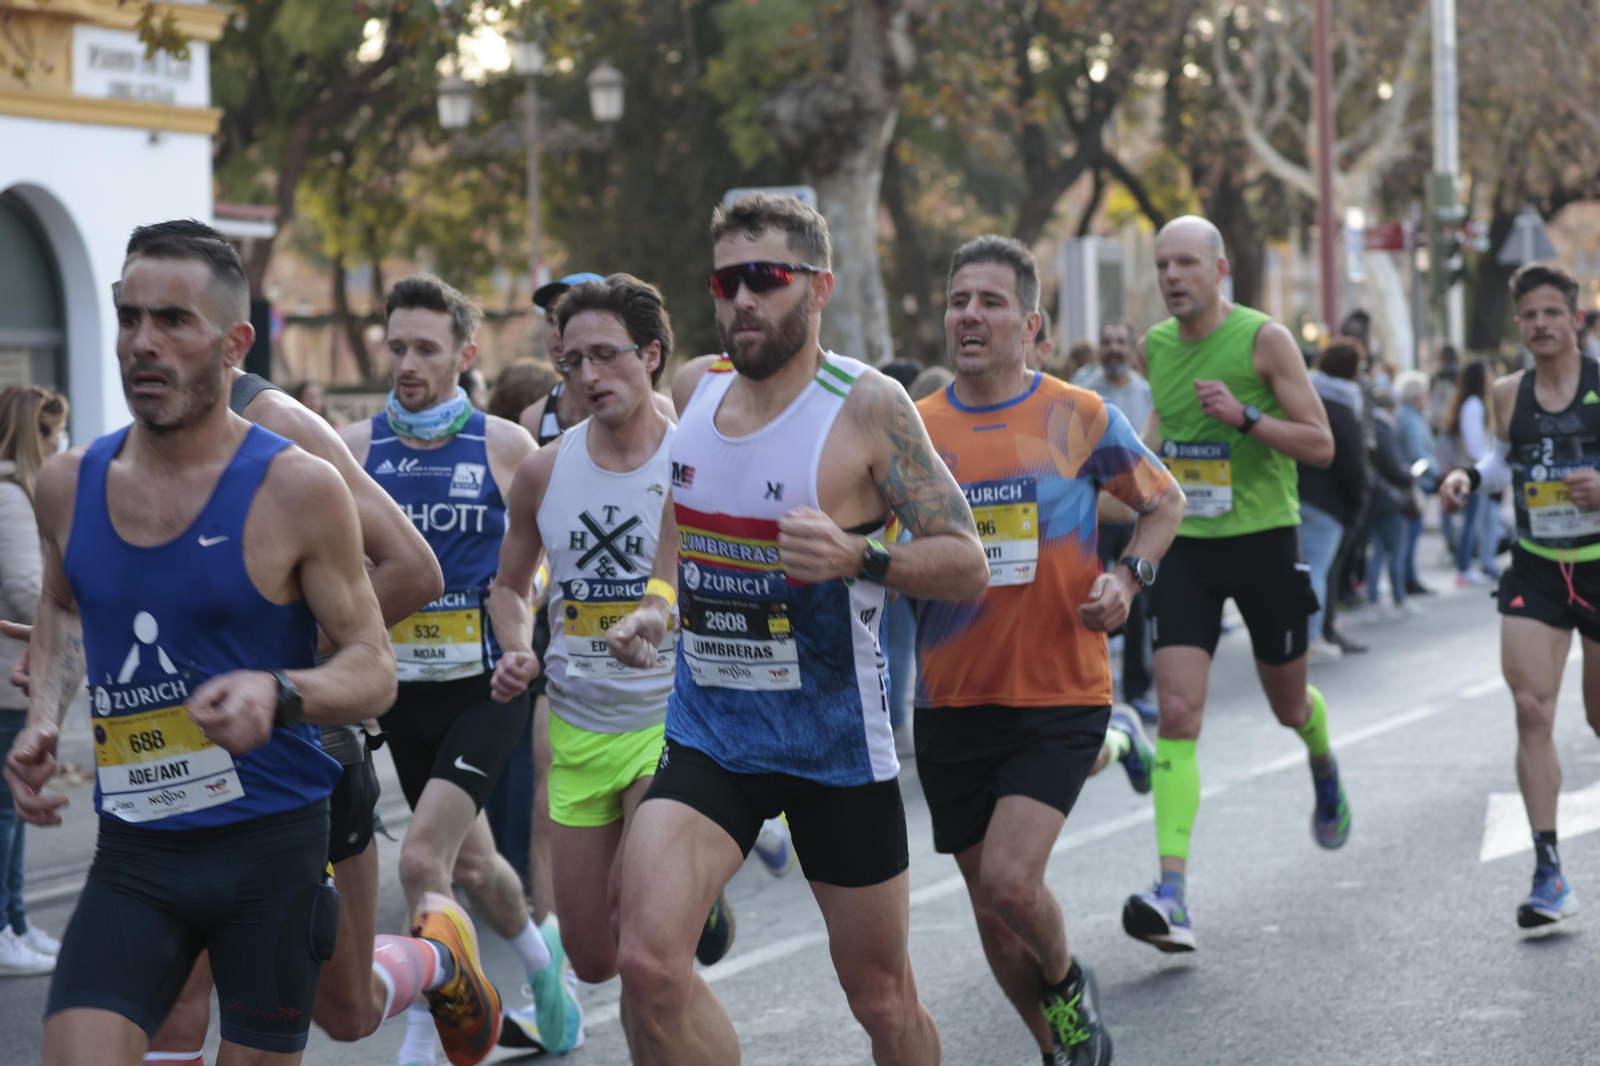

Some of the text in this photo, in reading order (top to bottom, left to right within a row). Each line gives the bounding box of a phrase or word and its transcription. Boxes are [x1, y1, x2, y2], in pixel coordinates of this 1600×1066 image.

[679, 531, 780, 565] LUMBRERAS
[702, 572, 771, 595] ZURICH
[414, 625, 440, 639] 532
[704, 610, 748, 632] 2608
[692, 638, 774, 660] LUMBRERAS
[112, 679, 189, 710] ZURICH
[128, 729, 166, 755] 688
[128, 760, 190, 786] ADE/ANT
